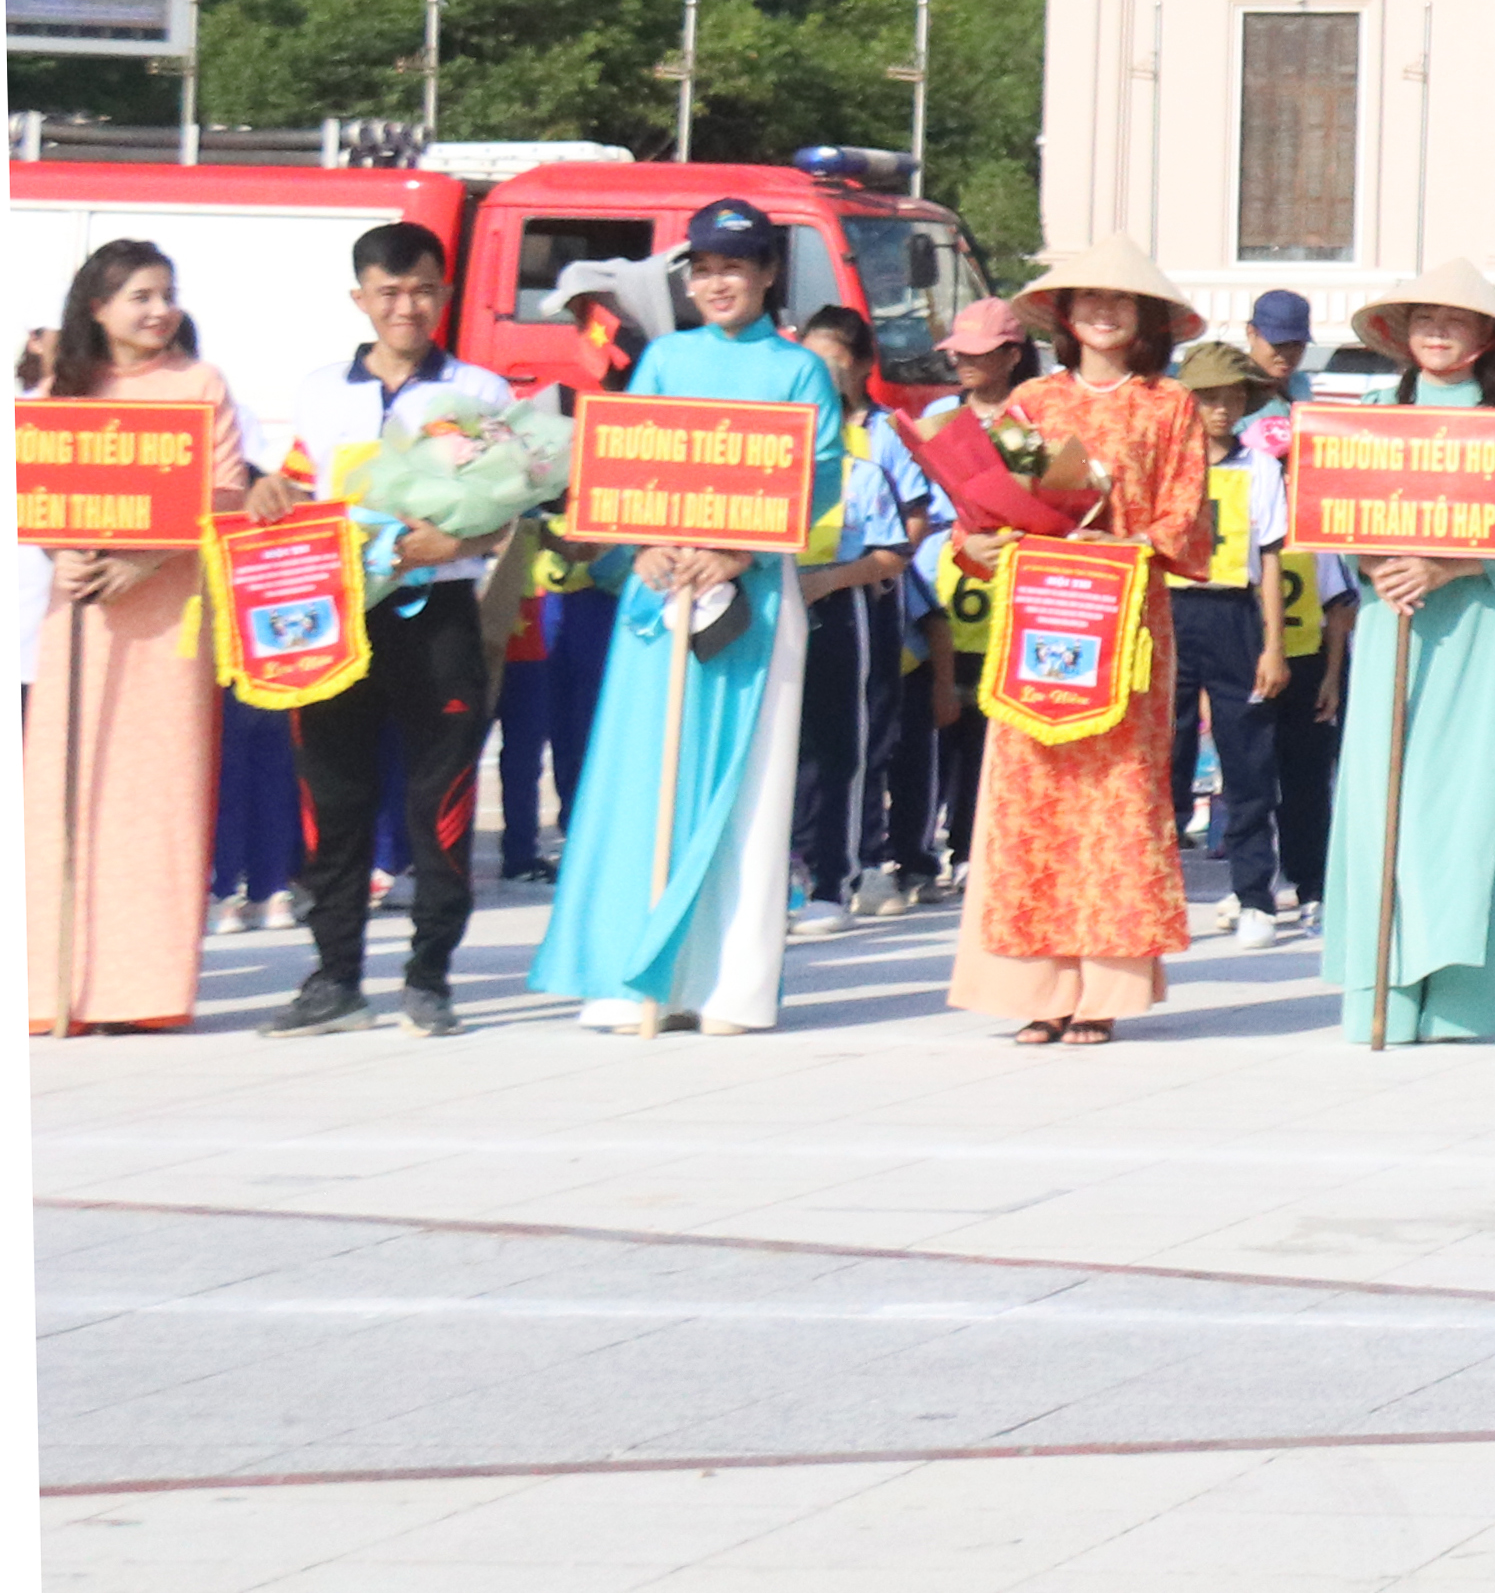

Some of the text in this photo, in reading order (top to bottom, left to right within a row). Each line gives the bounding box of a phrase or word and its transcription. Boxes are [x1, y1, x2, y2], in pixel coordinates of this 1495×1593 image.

[76, 418, 135, 466] TIỂU
[138, 431, 193, 473] HỌC
[594, 417, 795, 475] TRƯỜNG TIỂU HỌC
[1311, 428, 1405, 471] TRƯỜNG
[1408, 425, 1461, 473] TIỂU
[69, 493, 152, 538] THẠNH
[590, 477, 790, 534] THỊ TRẤN 1 DIÊN KHÁNH
[1319, 497, 1356, 543] THỊ
[1359, 488, 1418, 537] TRẤN
[1420, 494, 1449, 538] TÔ
